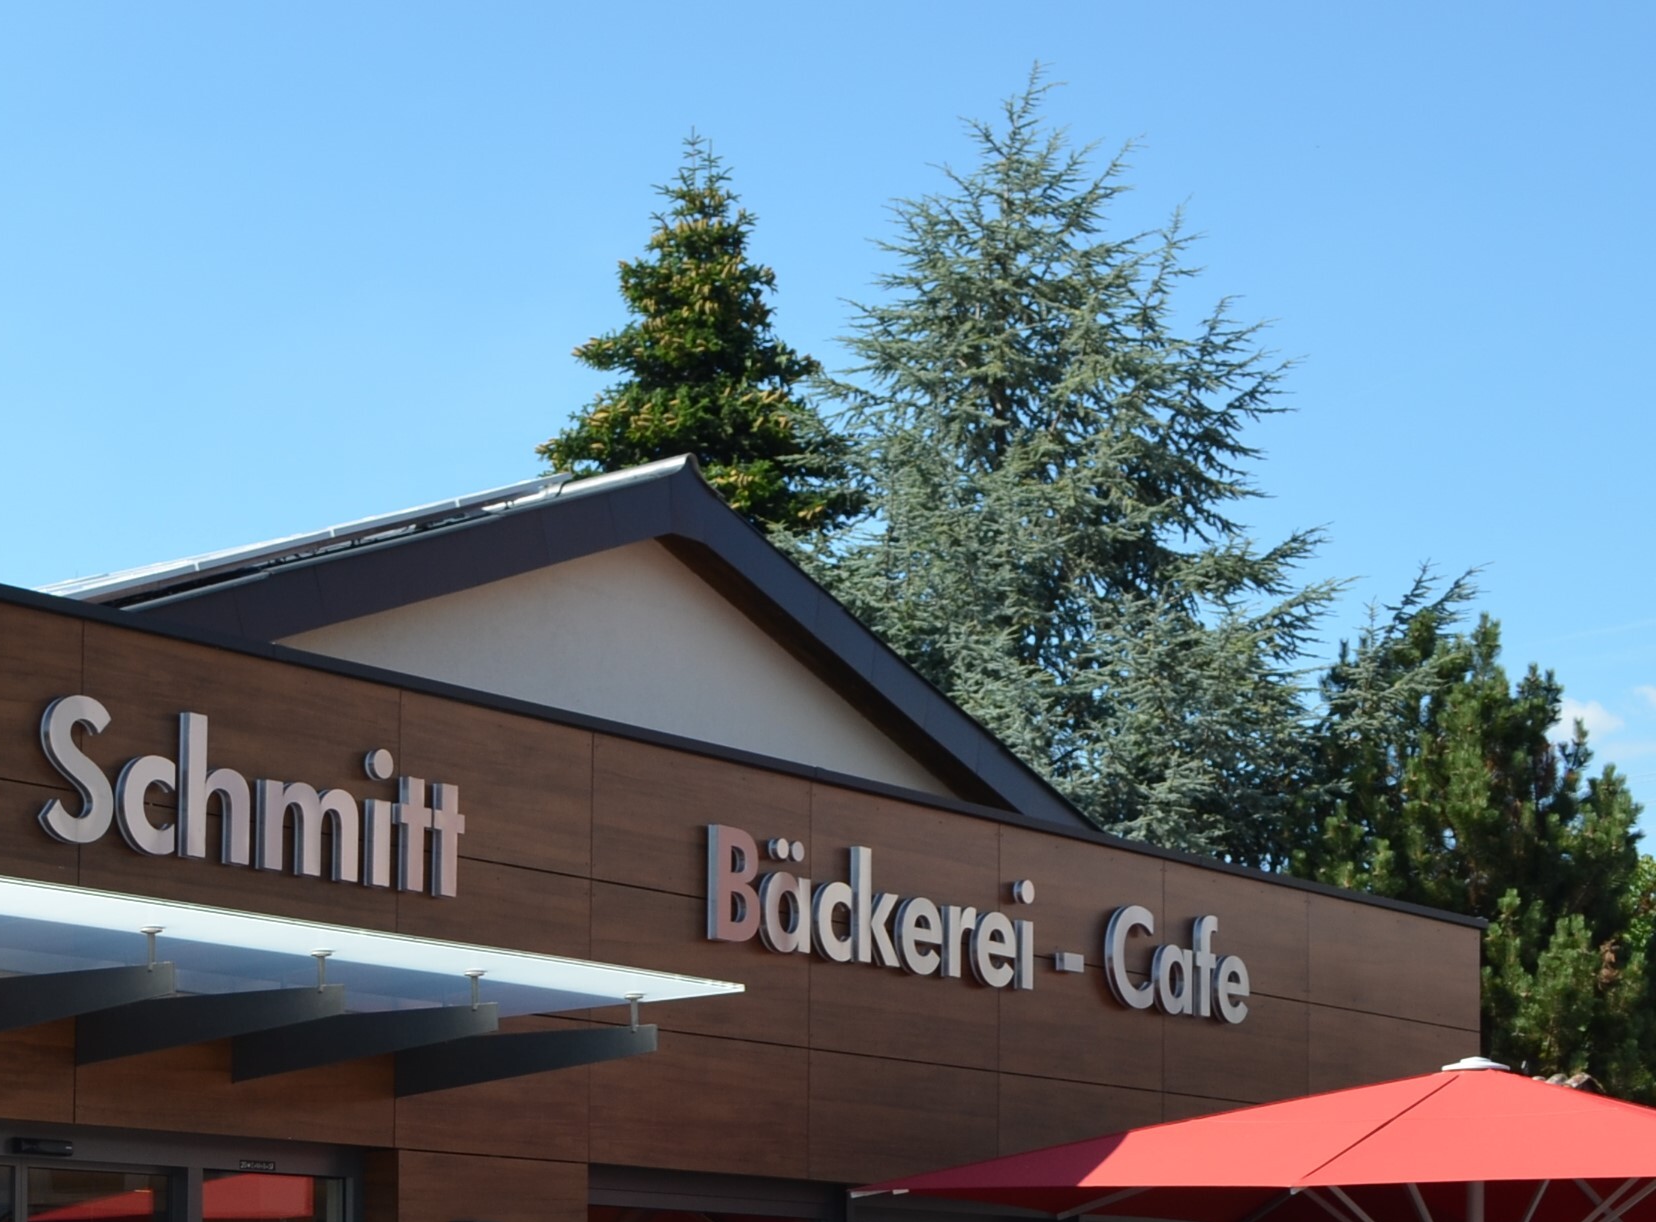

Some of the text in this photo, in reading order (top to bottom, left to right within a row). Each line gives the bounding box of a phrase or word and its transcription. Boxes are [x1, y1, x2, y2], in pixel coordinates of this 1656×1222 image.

[37, 694, 466, 898] Schmitt
[707, 823, 1035, 990] Bäckerei
[1104, 905, 1250, 1024] Cafe
